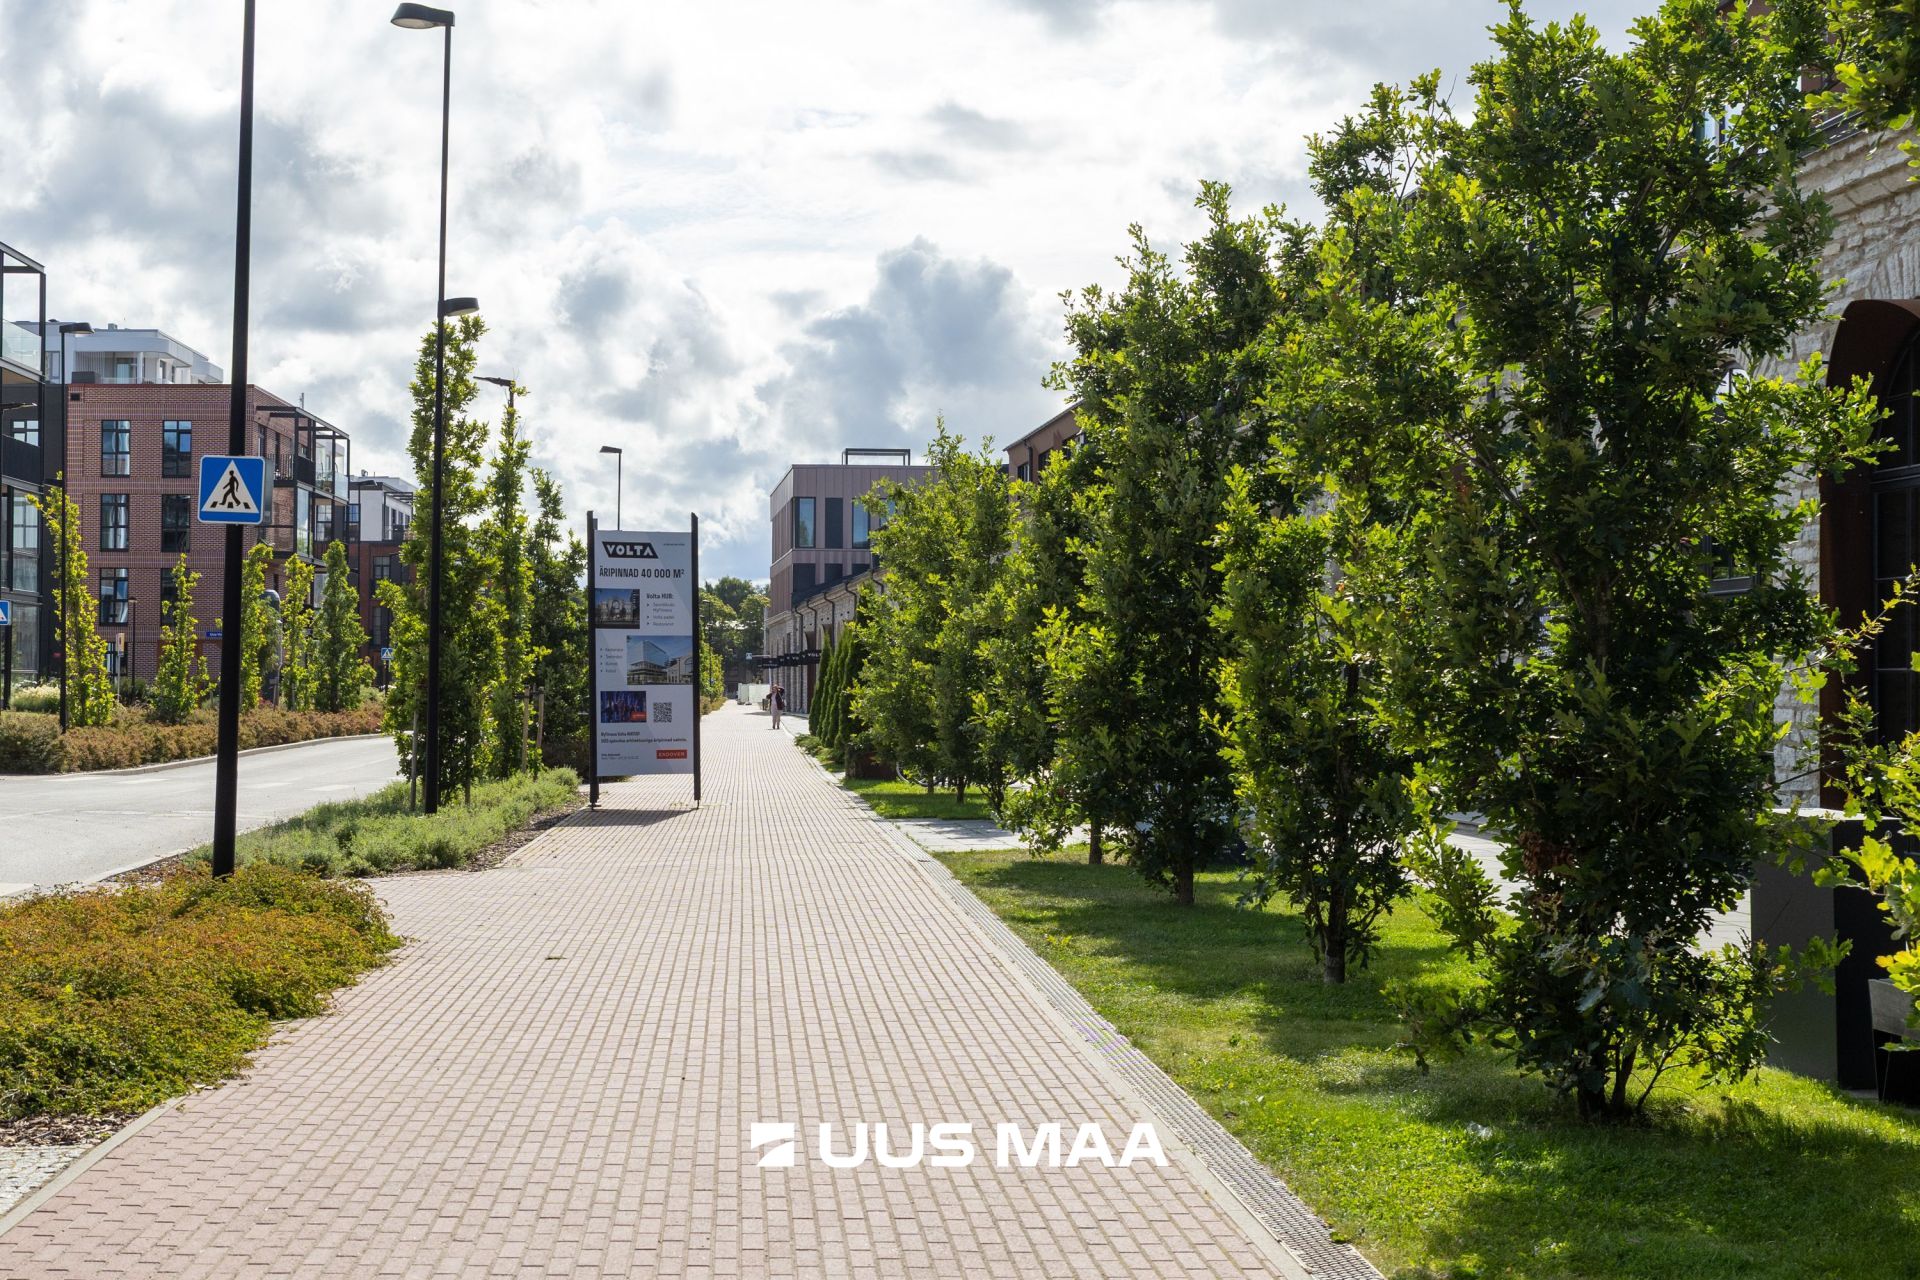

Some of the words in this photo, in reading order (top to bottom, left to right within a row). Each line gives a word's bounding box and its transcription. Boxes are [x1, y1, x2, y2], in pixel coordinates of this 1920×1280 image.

[605, 543, 654, 557] VOLTA
[599, 565, 639, 578] ÄRIPINNAD
[641, 568, 652, 578] 40
[654, 568, 671, 579] 000
